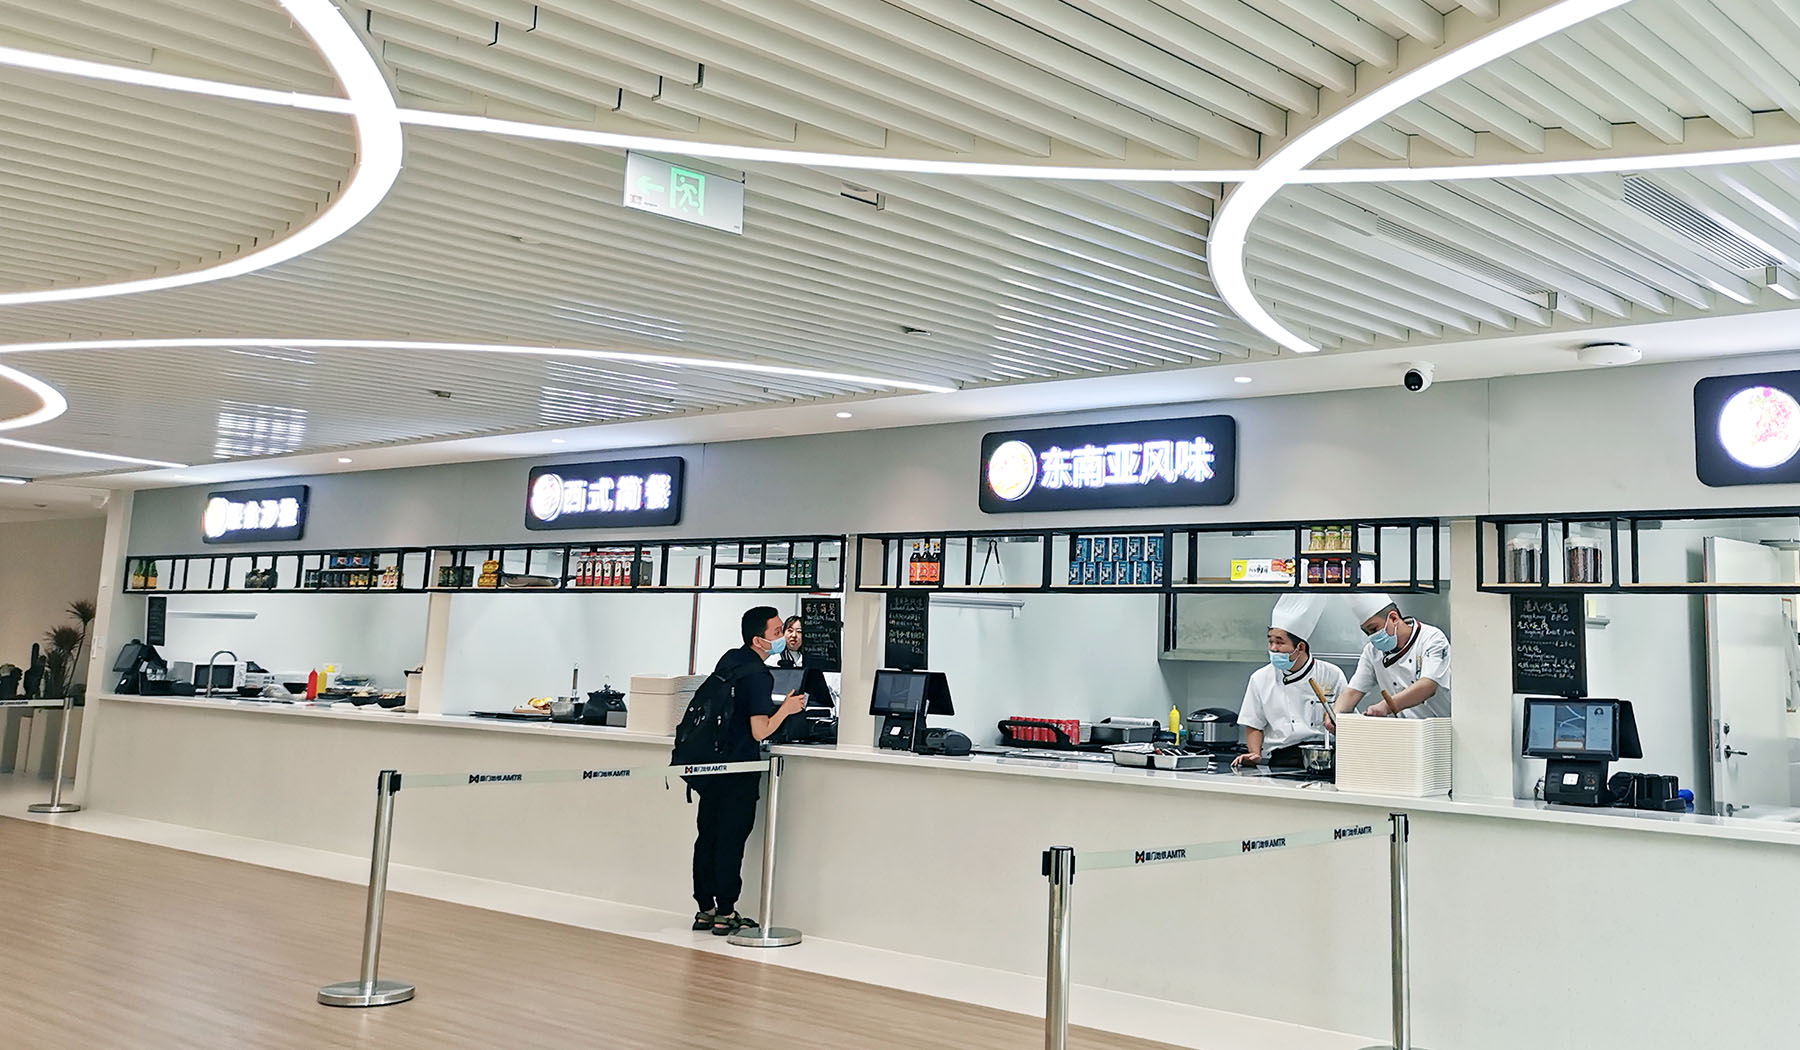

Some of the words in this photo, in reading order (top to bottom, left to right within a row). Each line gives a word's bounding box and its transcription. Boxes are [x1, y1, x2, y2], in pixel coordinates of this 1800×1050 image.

[1039, 436, 1216, 489] 东南亚风味
